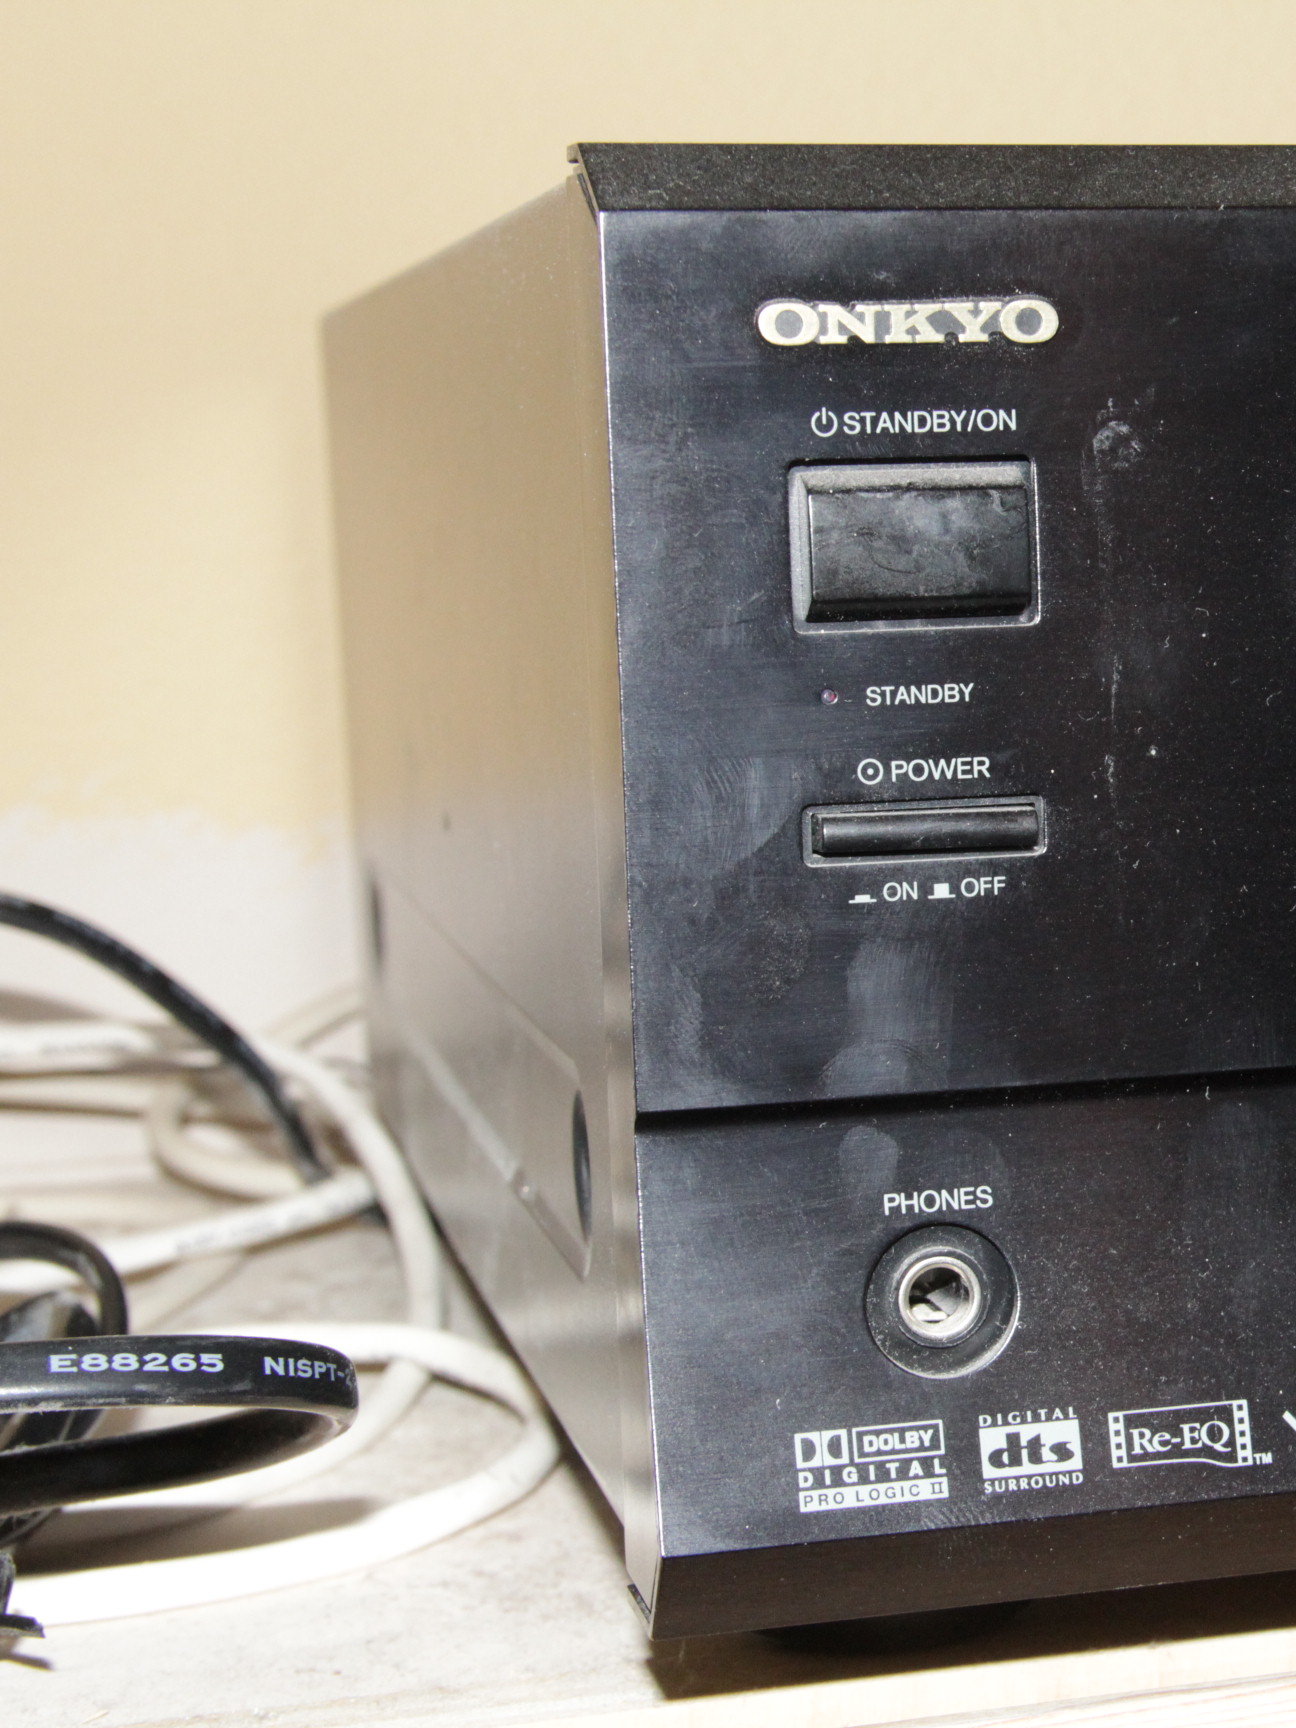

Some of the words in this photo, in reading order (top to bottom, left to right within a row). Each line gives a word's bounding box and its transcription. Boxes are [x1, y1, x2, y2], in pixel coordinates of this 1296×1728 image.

[757, 299, 1059, 346] ONKYO
[844, 409, 1017, 435] STANDBY/ON
[866, 683, 974, 706] STANDBY
[890, 756, 991, 782] POWER
[882, 881, 918, 902] ON
[960, 876, 1006, 898] OFF
[883, 1185, 994, 1216] PHONES
[49, 1353, 226, 1374] E88265
[978, 1406, 1078, 1428] DIGITAL
[862, 1428, 934, 1454] DOLBY
[987, 1431, 1076, 1470] dts
[1130, 1419, 1232, 1456] Re-EQ
[798, 1458, 948, 1489] DIGITAL
[983, 1471, 1084, 1495] SURROUND
[803, 1491, 845, 1509] PRO
[855, 1483, 921, 1504] LOGIC
